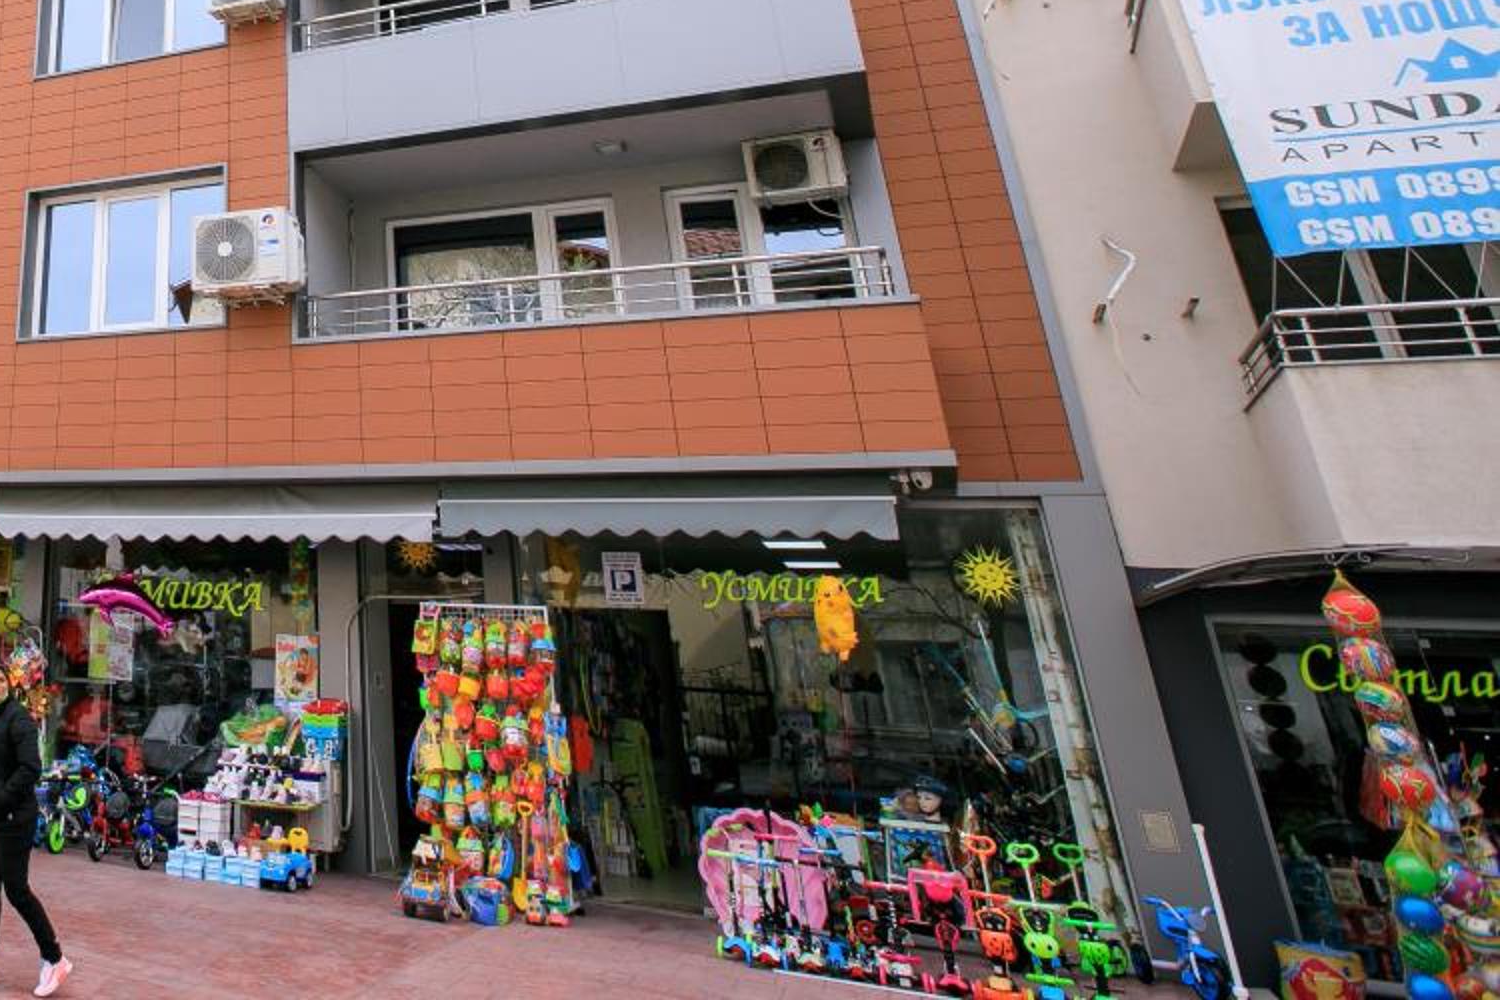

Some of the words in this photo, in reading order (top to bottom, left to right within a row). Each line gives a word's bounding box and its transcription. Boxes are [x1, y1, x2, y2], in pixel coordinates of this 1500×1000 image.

[1283, 10, 1350, 47] ЗА
[1269, 91, 1500, 134] SUND
[1282, 131, 1485, 163] APART
[1284, 176, 1381, 208] GSM
[1298, 214, 1395, 246] GSM
[86, 572, 266, 617] МИВКА
